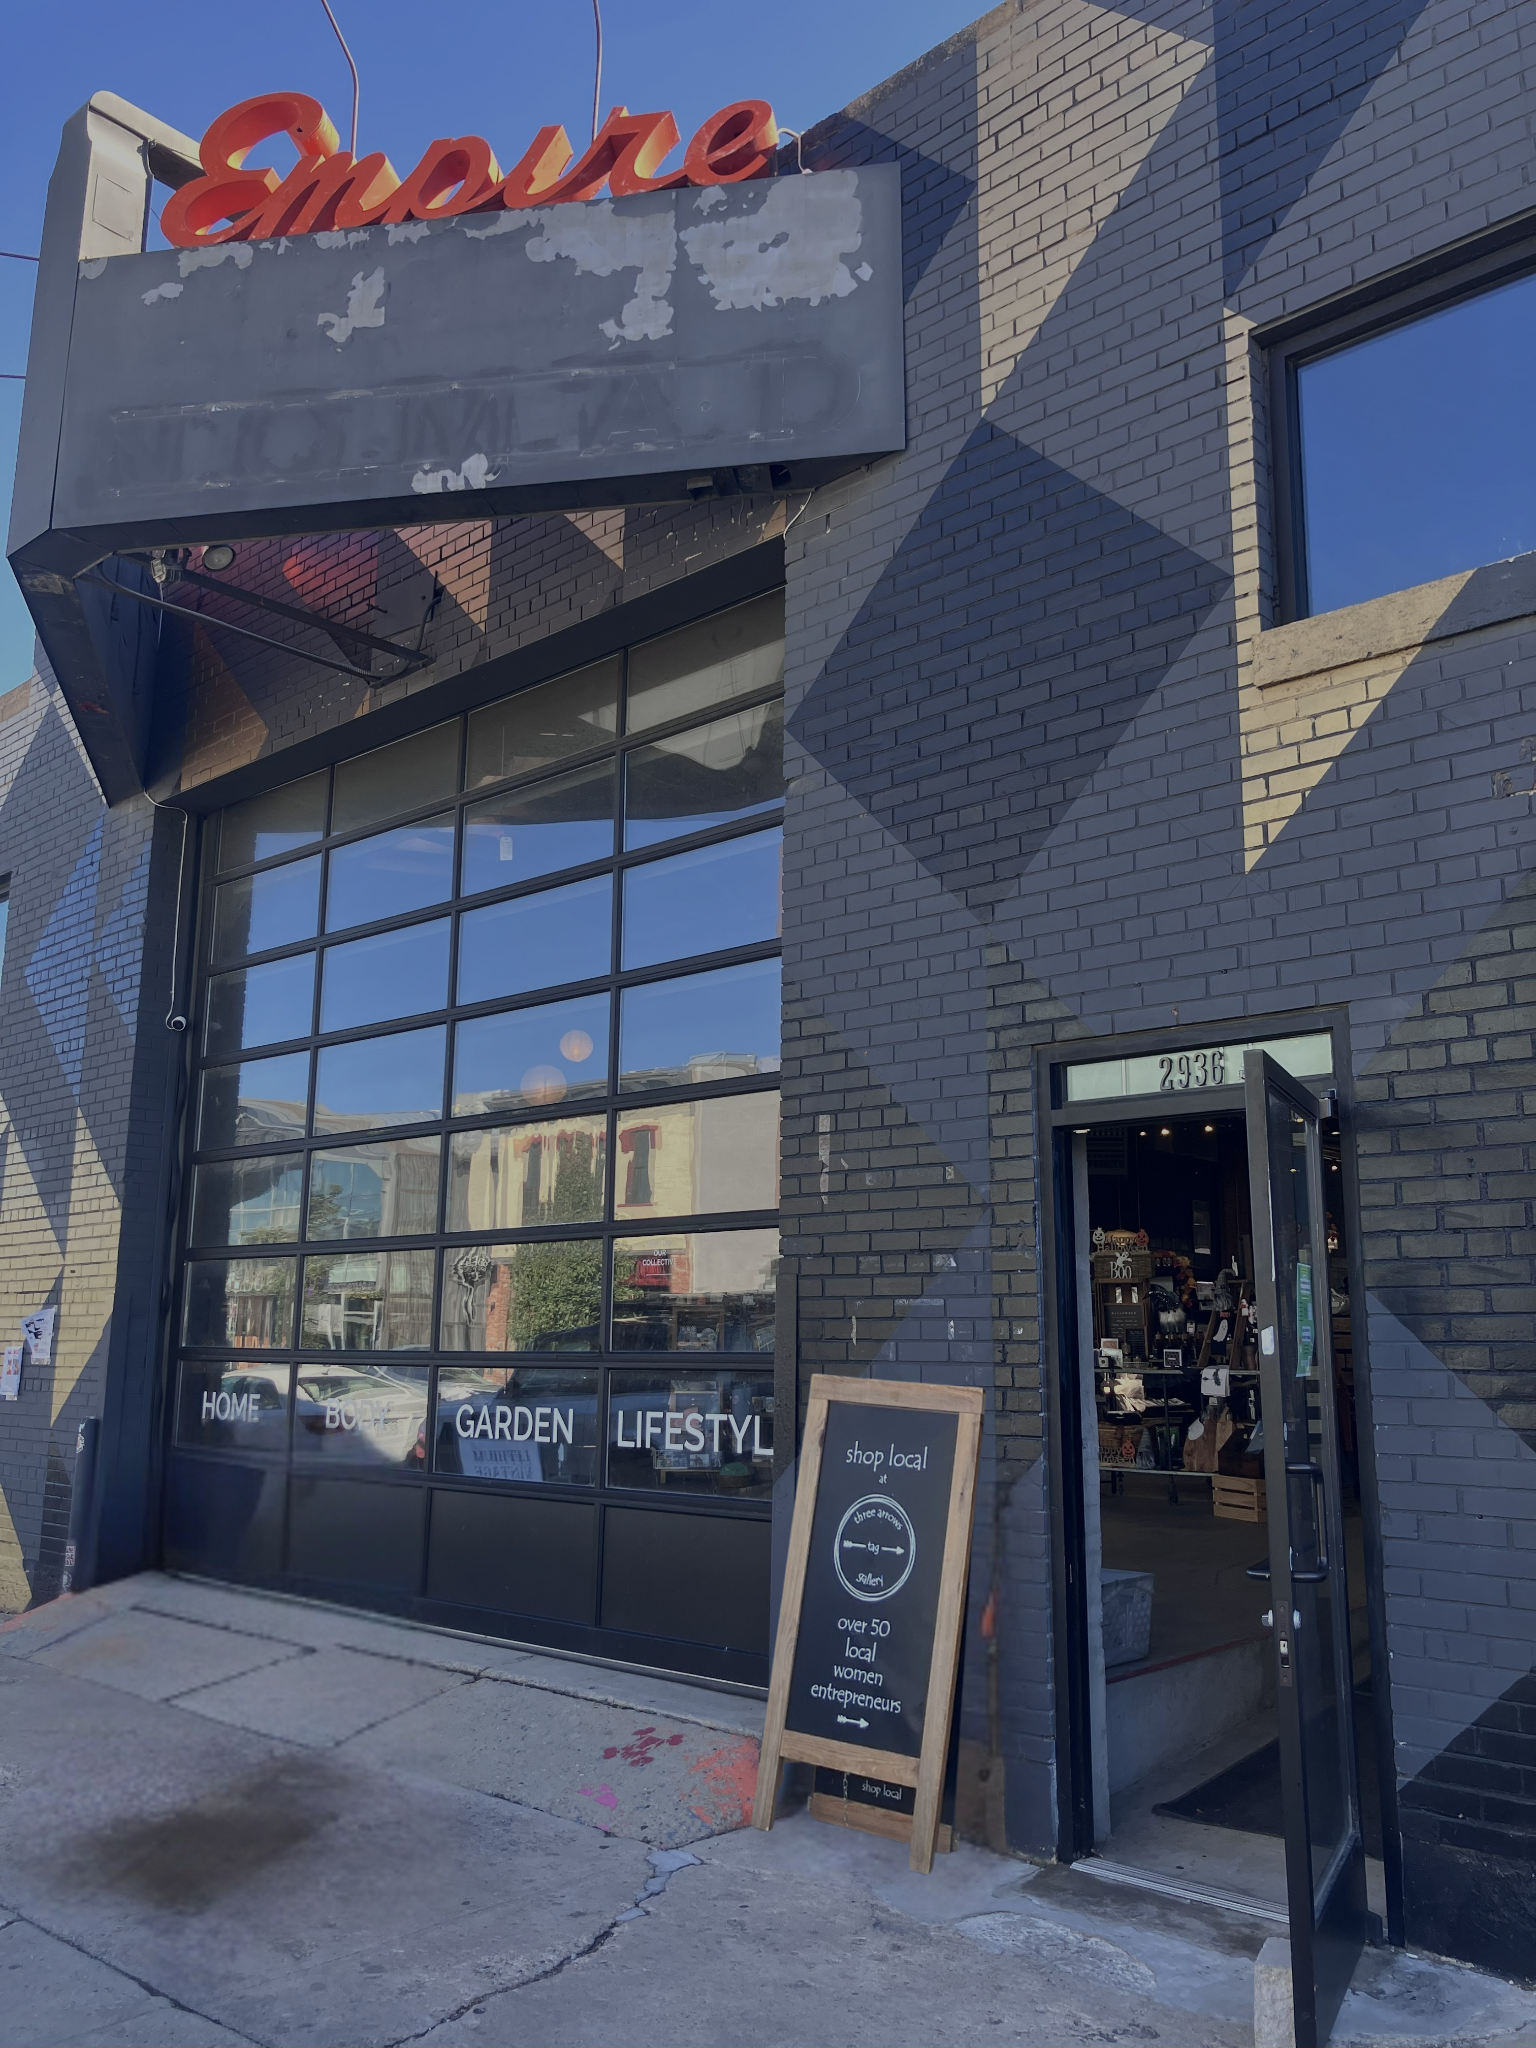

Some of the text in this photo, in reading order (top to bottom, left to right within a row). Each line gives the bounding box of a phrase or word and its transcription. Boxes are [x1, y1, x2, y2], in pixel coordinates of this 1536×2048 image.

[1158, 1050, 1225, 1091] 2936
[642, 1258, 677, 1266] COLLECTIVE
[653, 1249, 667, 1257] OUR
[201, 1391, 261, 1423] HOME
[324, 1399, 391, 1430] BODY
[455, 1404, 574, 1444] GARDEN
[845, 1440, 928, 1472] shop local
[878, 1474, 888, 1484] at
[853, 1508, 903, 1531] three arrows
[867, 1541, 880, 1555] tag
[837, 1617, 891, 1637] over 50
[845, 1637, 877, 1663] local
[833, 1664, 883, 1687] women
[811, 1683, 902, 1714] entrepreneurs
[861, 1779, 903, 1801] shop local
